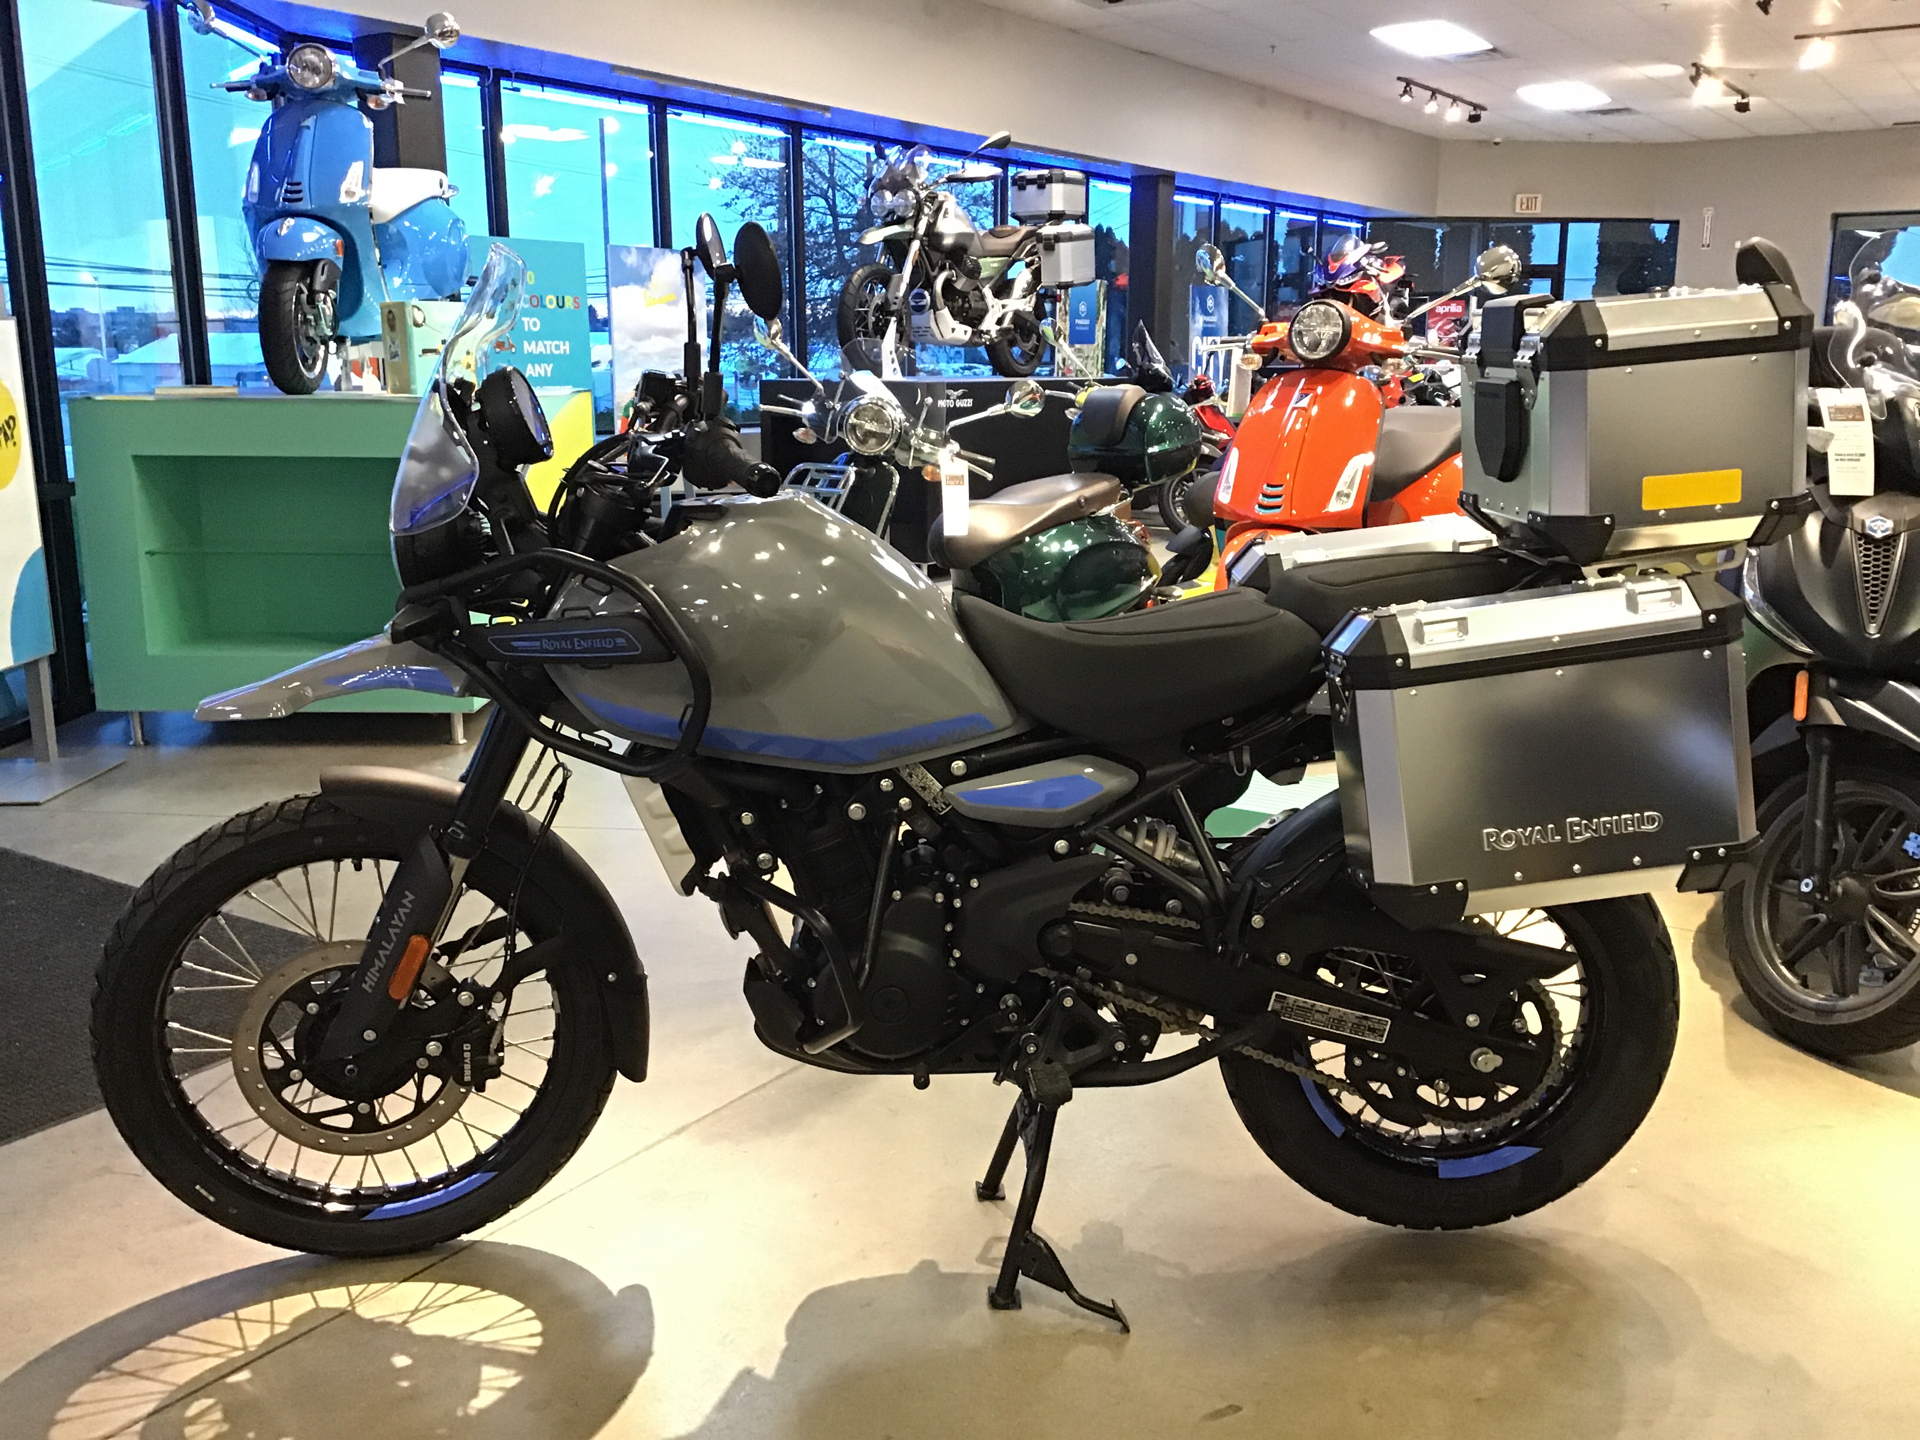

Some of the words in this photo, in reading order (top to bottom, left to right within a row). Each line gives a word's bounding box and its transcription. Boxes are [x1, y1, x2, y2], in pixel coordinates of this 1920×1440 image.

[1519, 196, 1539, 211] EXIT
[521, 294, 581, 310] COLOURS
[1435, 303, 1463, 314] aprilia
[521, 317, 541, 332] TO
[523, 340, 570, 355] MATCH
[526, 363, 554, 377] ANY
[937, 399, 955, 408] MOTO
[955, 398, 974, 407] GUZZI
[541, 638, 572, 650] ROYAL
[574, 637, 614, 650] ENFIELD
[1483, 824, 1562, 851] ROYAL
[1566, 811, 1664, 843] ENFIELD
[361, 890, 416, 994] HIMALAYAN
